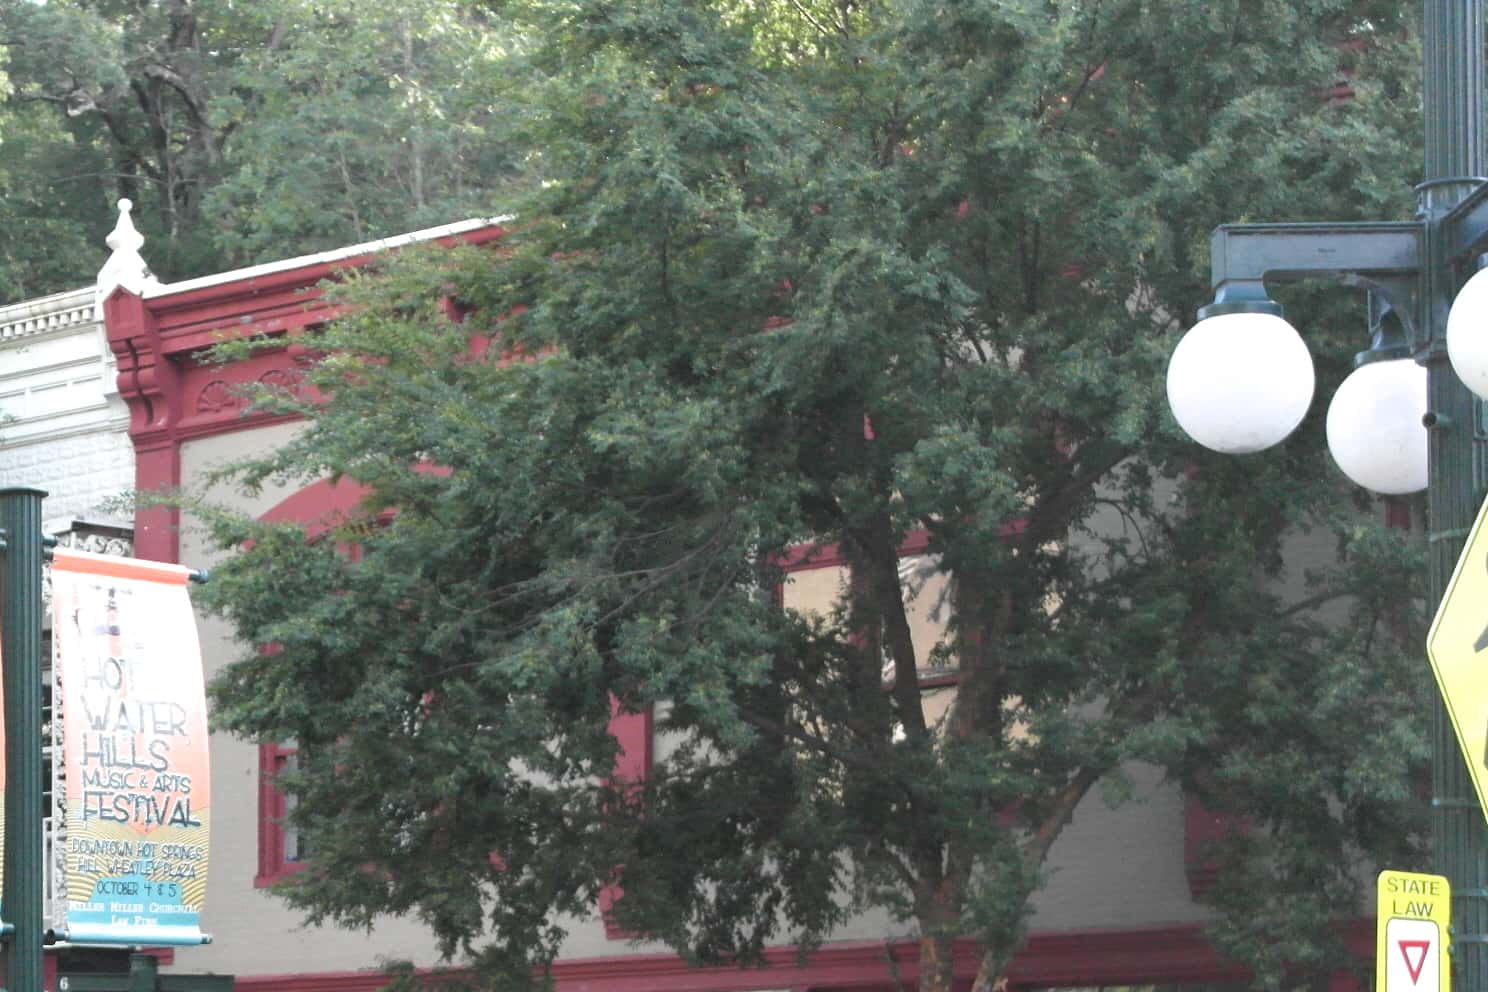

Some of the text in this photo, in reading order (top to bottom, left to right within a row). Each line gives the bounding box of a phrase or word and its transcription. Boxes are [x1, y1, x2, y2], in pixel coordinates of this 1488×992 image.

[80, 693, 188, 737] WATER
[80, 732, 170, 772] HILLS
[82, 768, 193, 794] MUSIC & ARTS
[80, 791, 201, 827] FESTIVAL
[72, 838, 204, 861] DOWNTOWN HOT SPRINGS
[96, 881, 139, 896] OCTOBER
[144, 883, 153, 896] 4
[168, 883, 177, 898] 5
[1387, 876, 1441, 897] STATE
[1393, 899, 1434, 918] LAW
